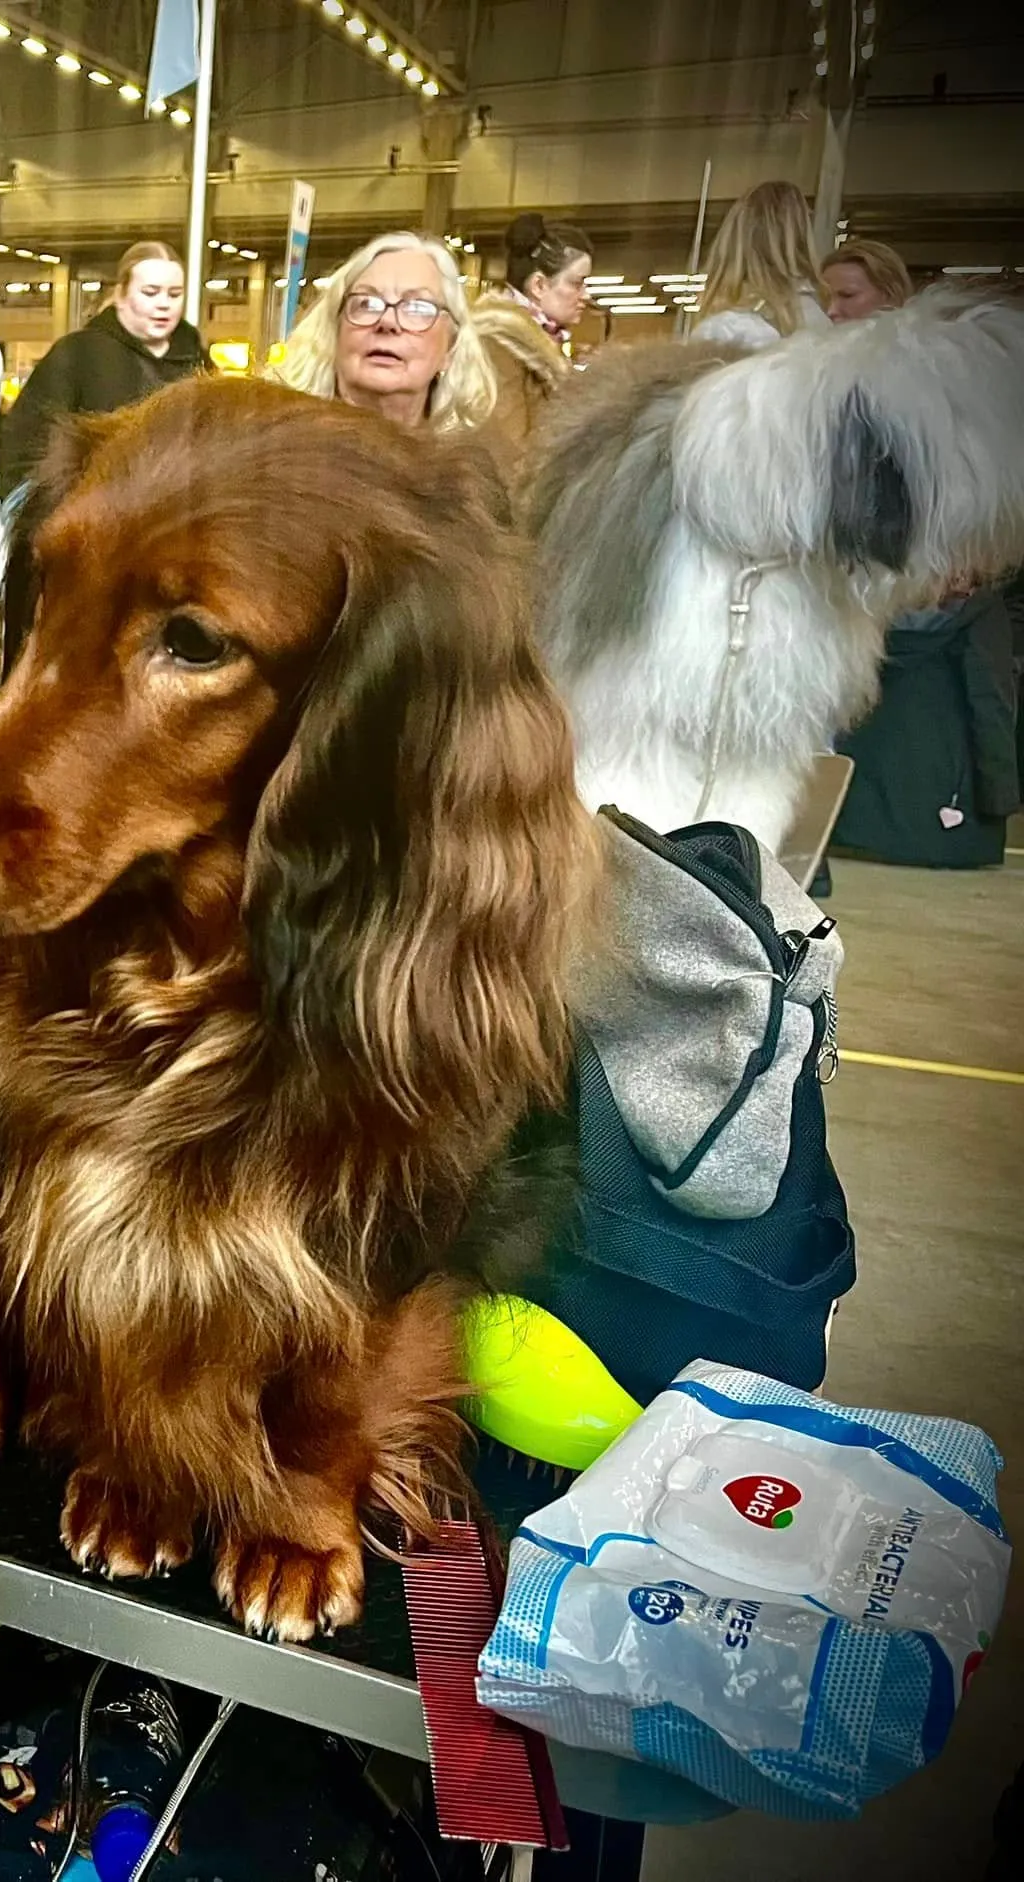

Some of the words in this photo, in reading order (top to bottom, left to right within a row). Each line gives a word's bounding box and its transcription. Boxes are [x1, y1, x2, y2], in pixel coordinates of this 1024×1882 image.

[745, 1480, 783, 1518] Ruta
[862, 1507, 925, 1621] ANTIBACTERIAL
[645, 1591, 671, 1620] 120
